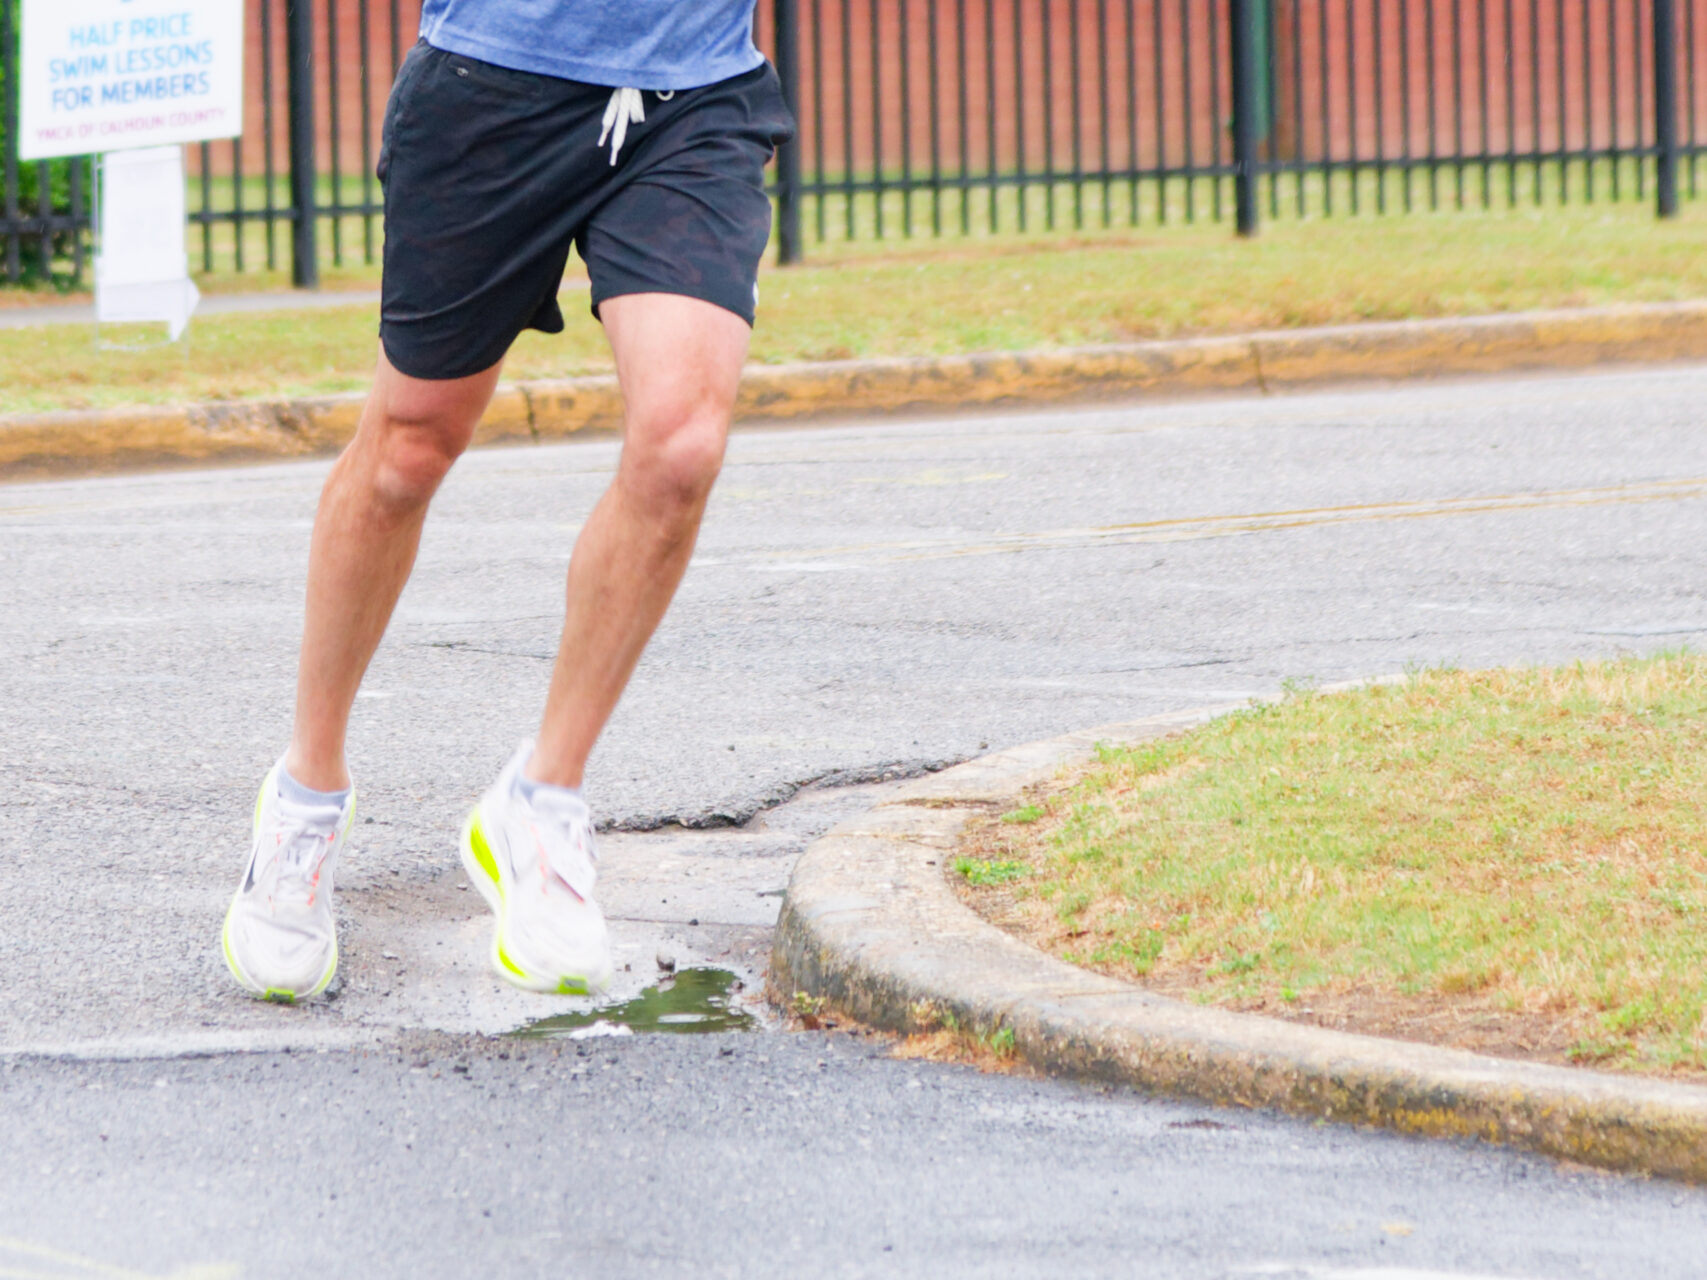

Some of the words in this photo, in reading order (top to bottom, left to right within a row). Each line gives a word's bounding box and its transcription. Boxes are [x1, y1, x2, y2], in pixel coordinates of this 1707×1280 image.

[69, 21, 123, 49] HALF
[130, 13, 192, 40] PRICE
[49, 56, 107, 83] SWIM
[116, 40, 213, 74] LESSONS
[52, 86, 93, 111] FOR
[102, 71, 210, 104] MEMBERS
[37, 125, 73, 141] YMCA
[79, 122, 94, 138] OF
[169, 108, 225, 127] COUNTY
